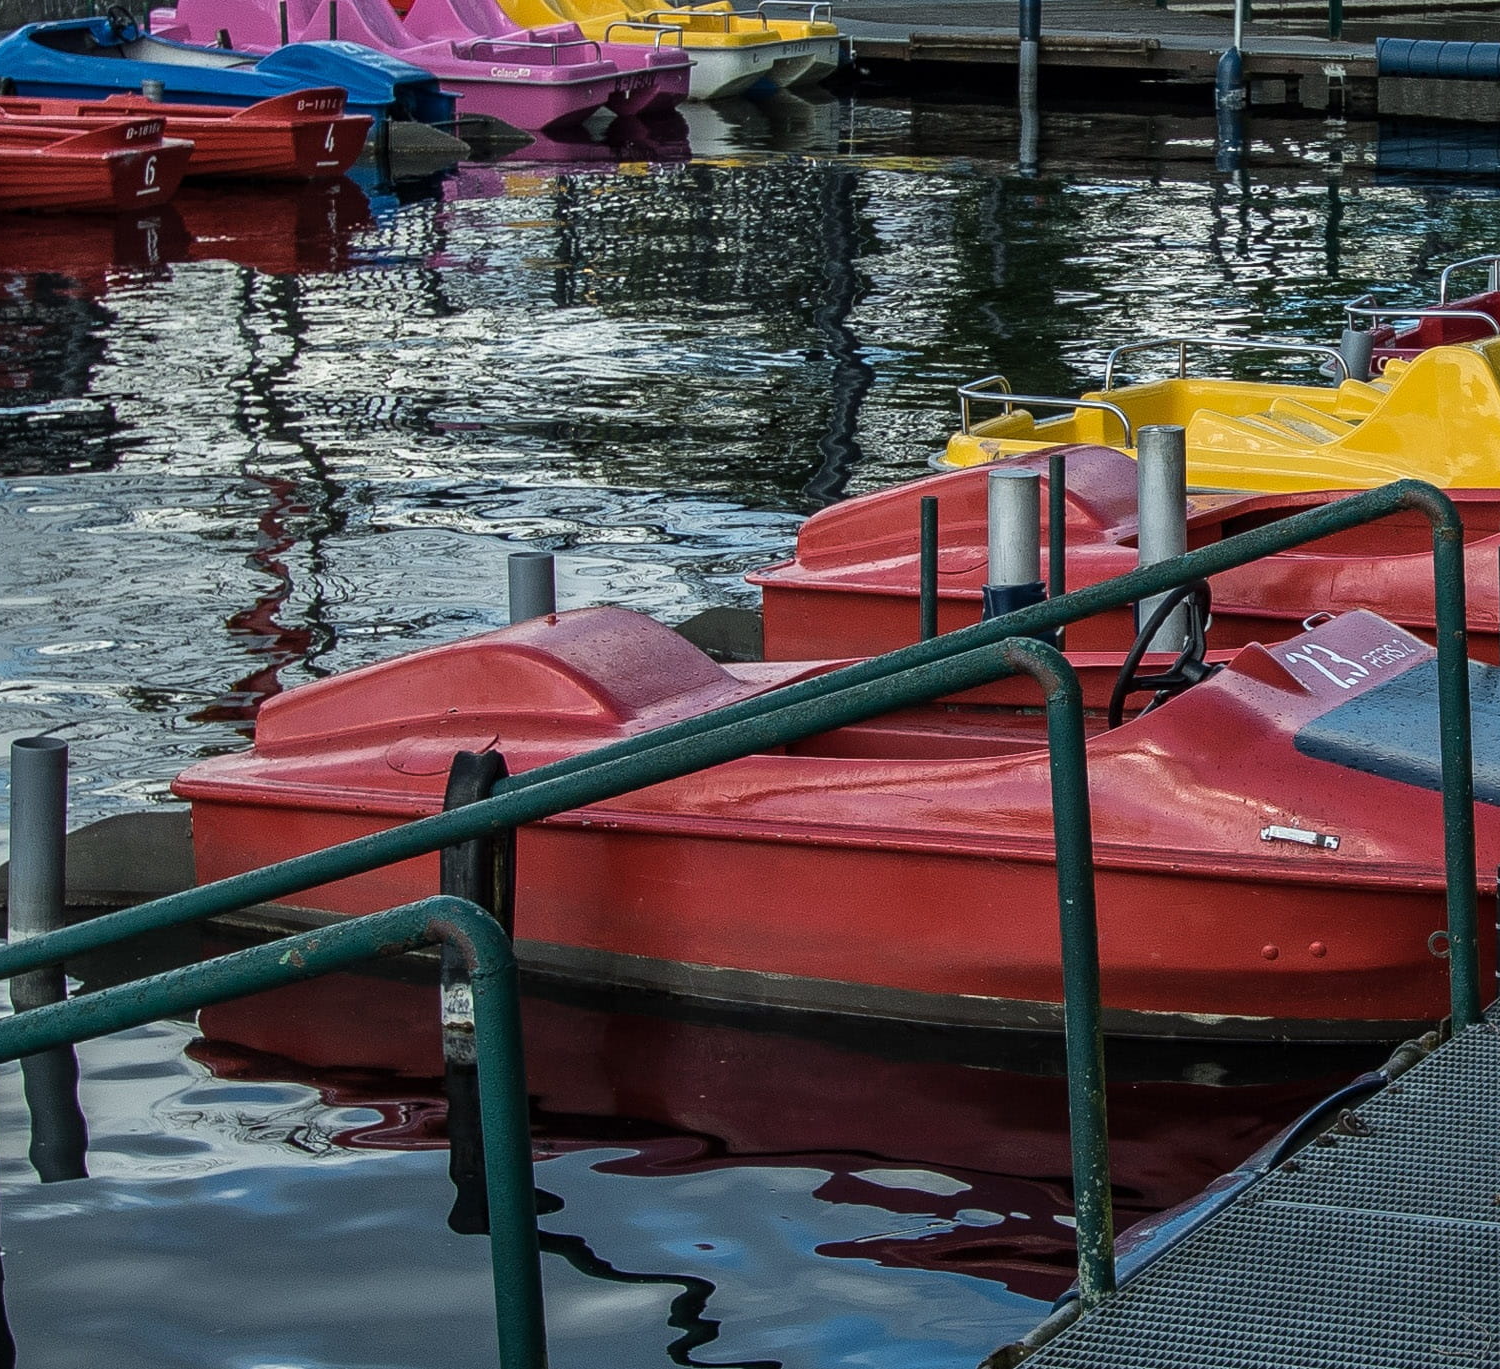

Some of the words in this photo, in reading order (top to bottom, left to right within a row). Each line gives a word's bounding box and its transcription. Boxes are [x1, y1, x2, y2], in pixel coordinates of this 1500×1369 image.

[325, 123, 335, 152] 4
[145, 155, 157, 185] 6
[1285, 642, 1370, 689] 23
